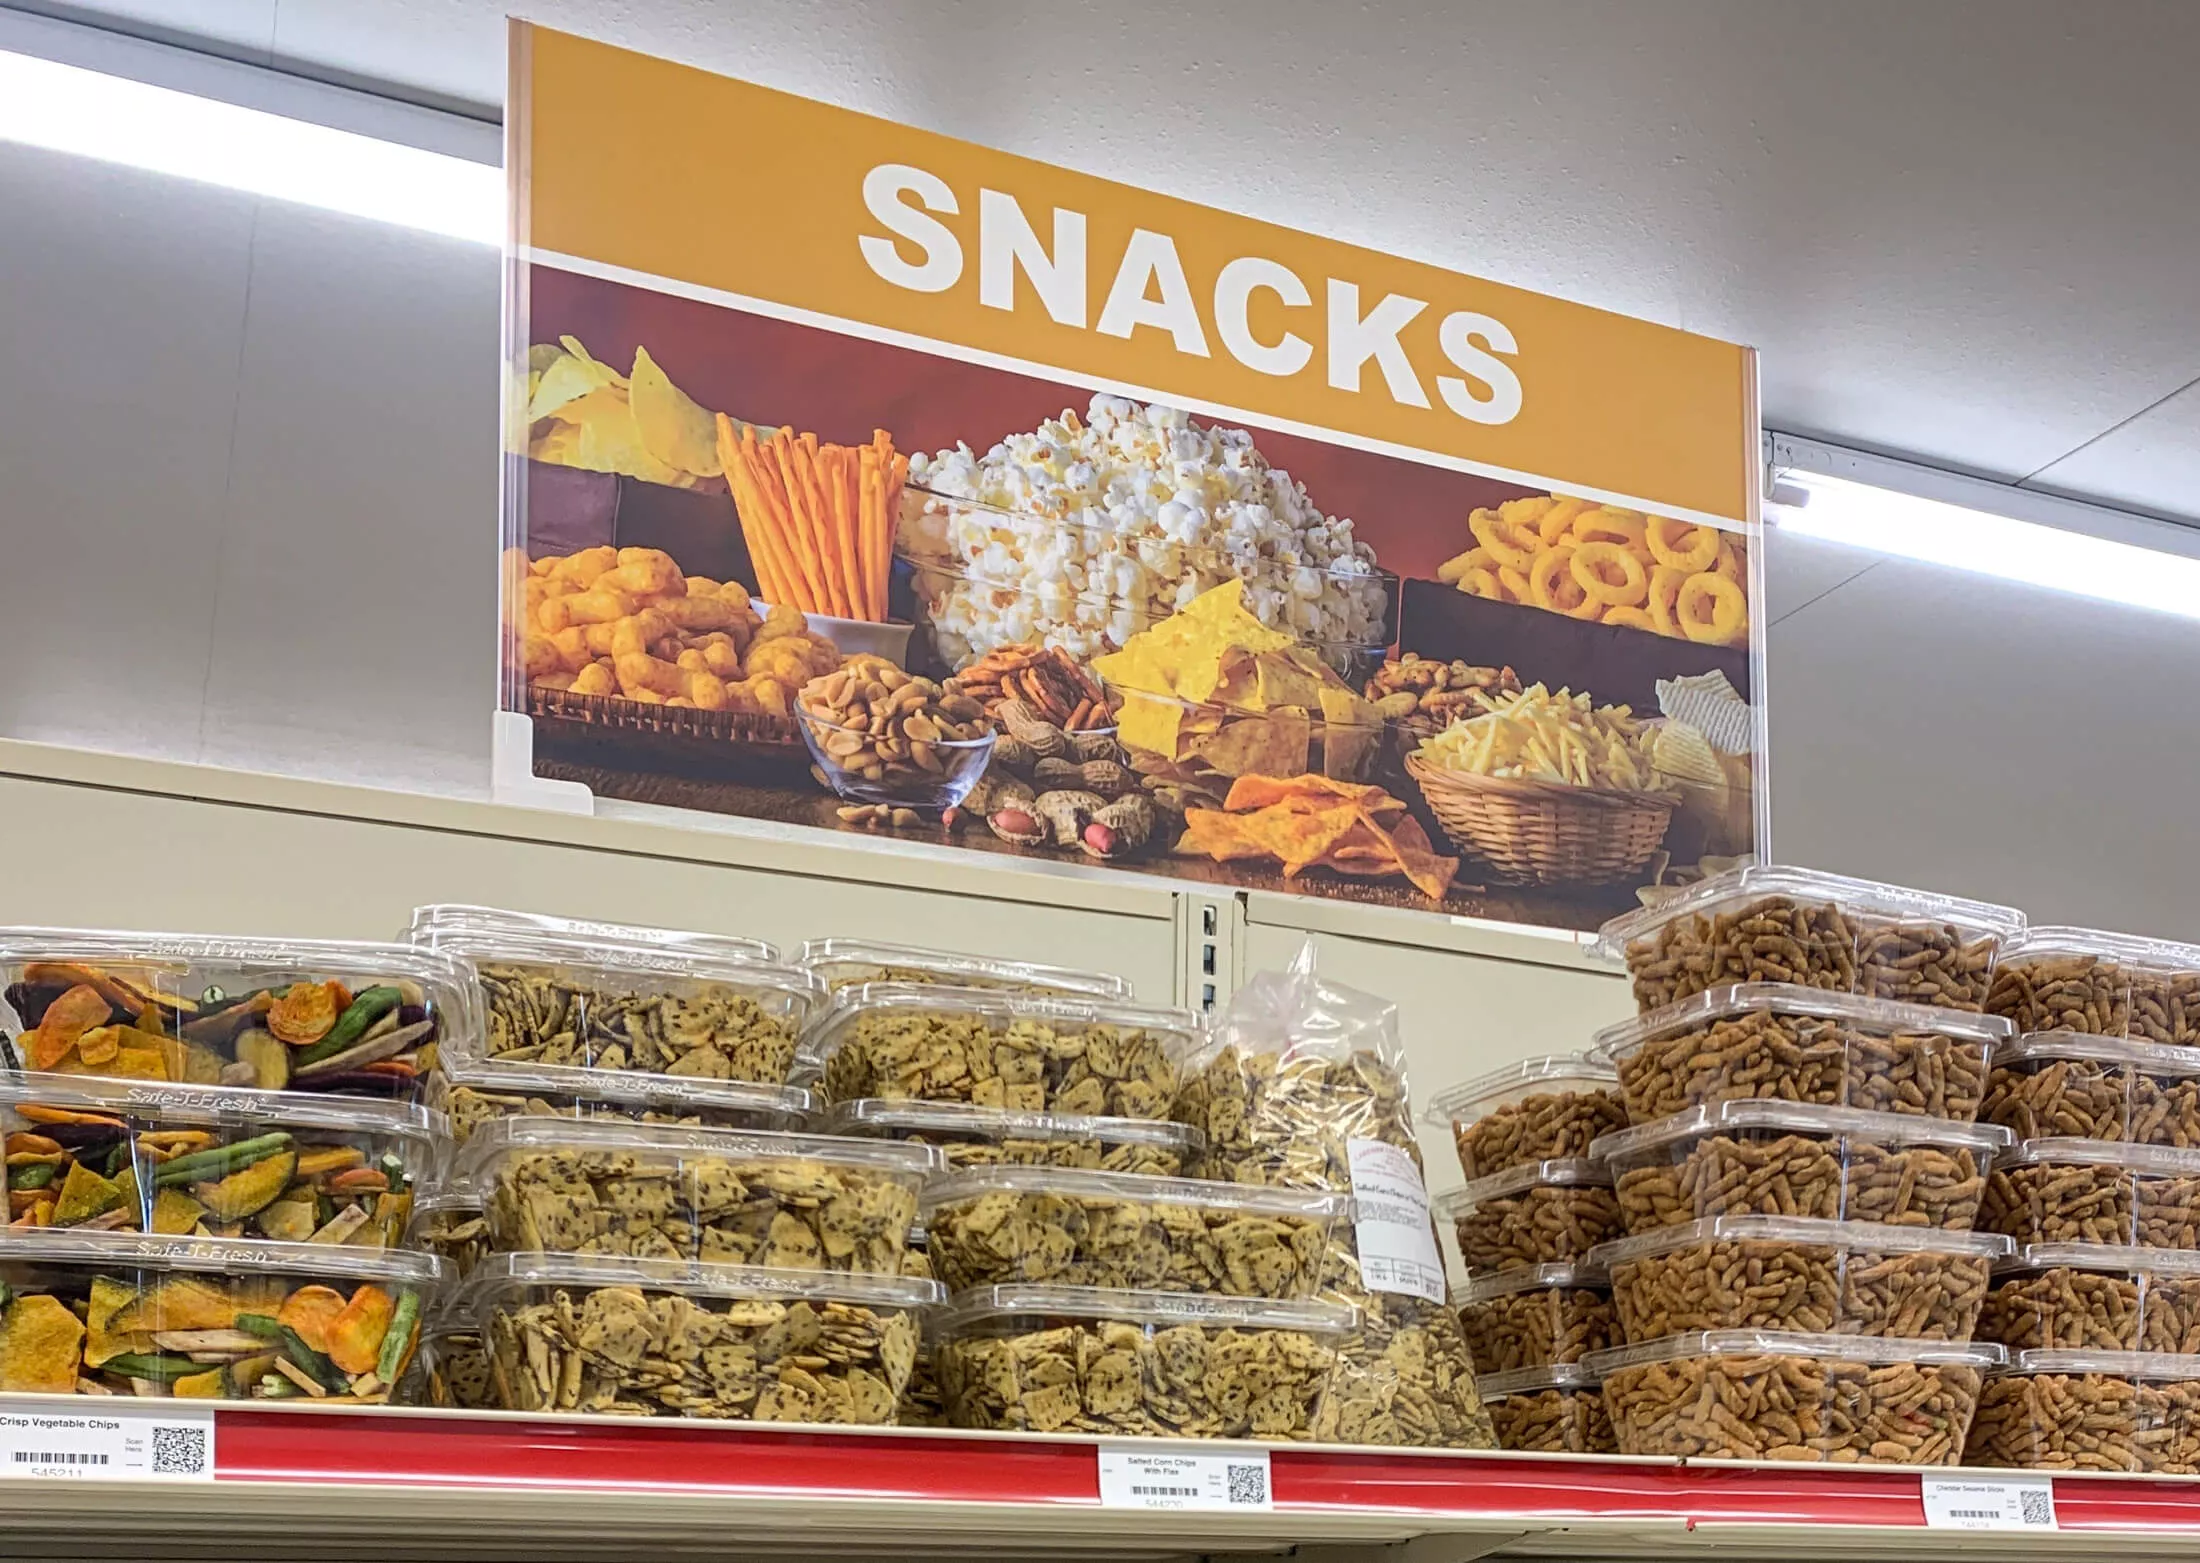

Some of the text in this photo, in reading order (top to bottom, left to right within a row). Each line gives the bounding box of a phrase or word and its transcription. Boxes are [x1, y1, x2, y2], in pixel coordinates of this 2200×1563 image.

[858, 163, 1523, 425] SNACKS
[0, 1417, 120, 1430] Crisp Vegetable Chips
